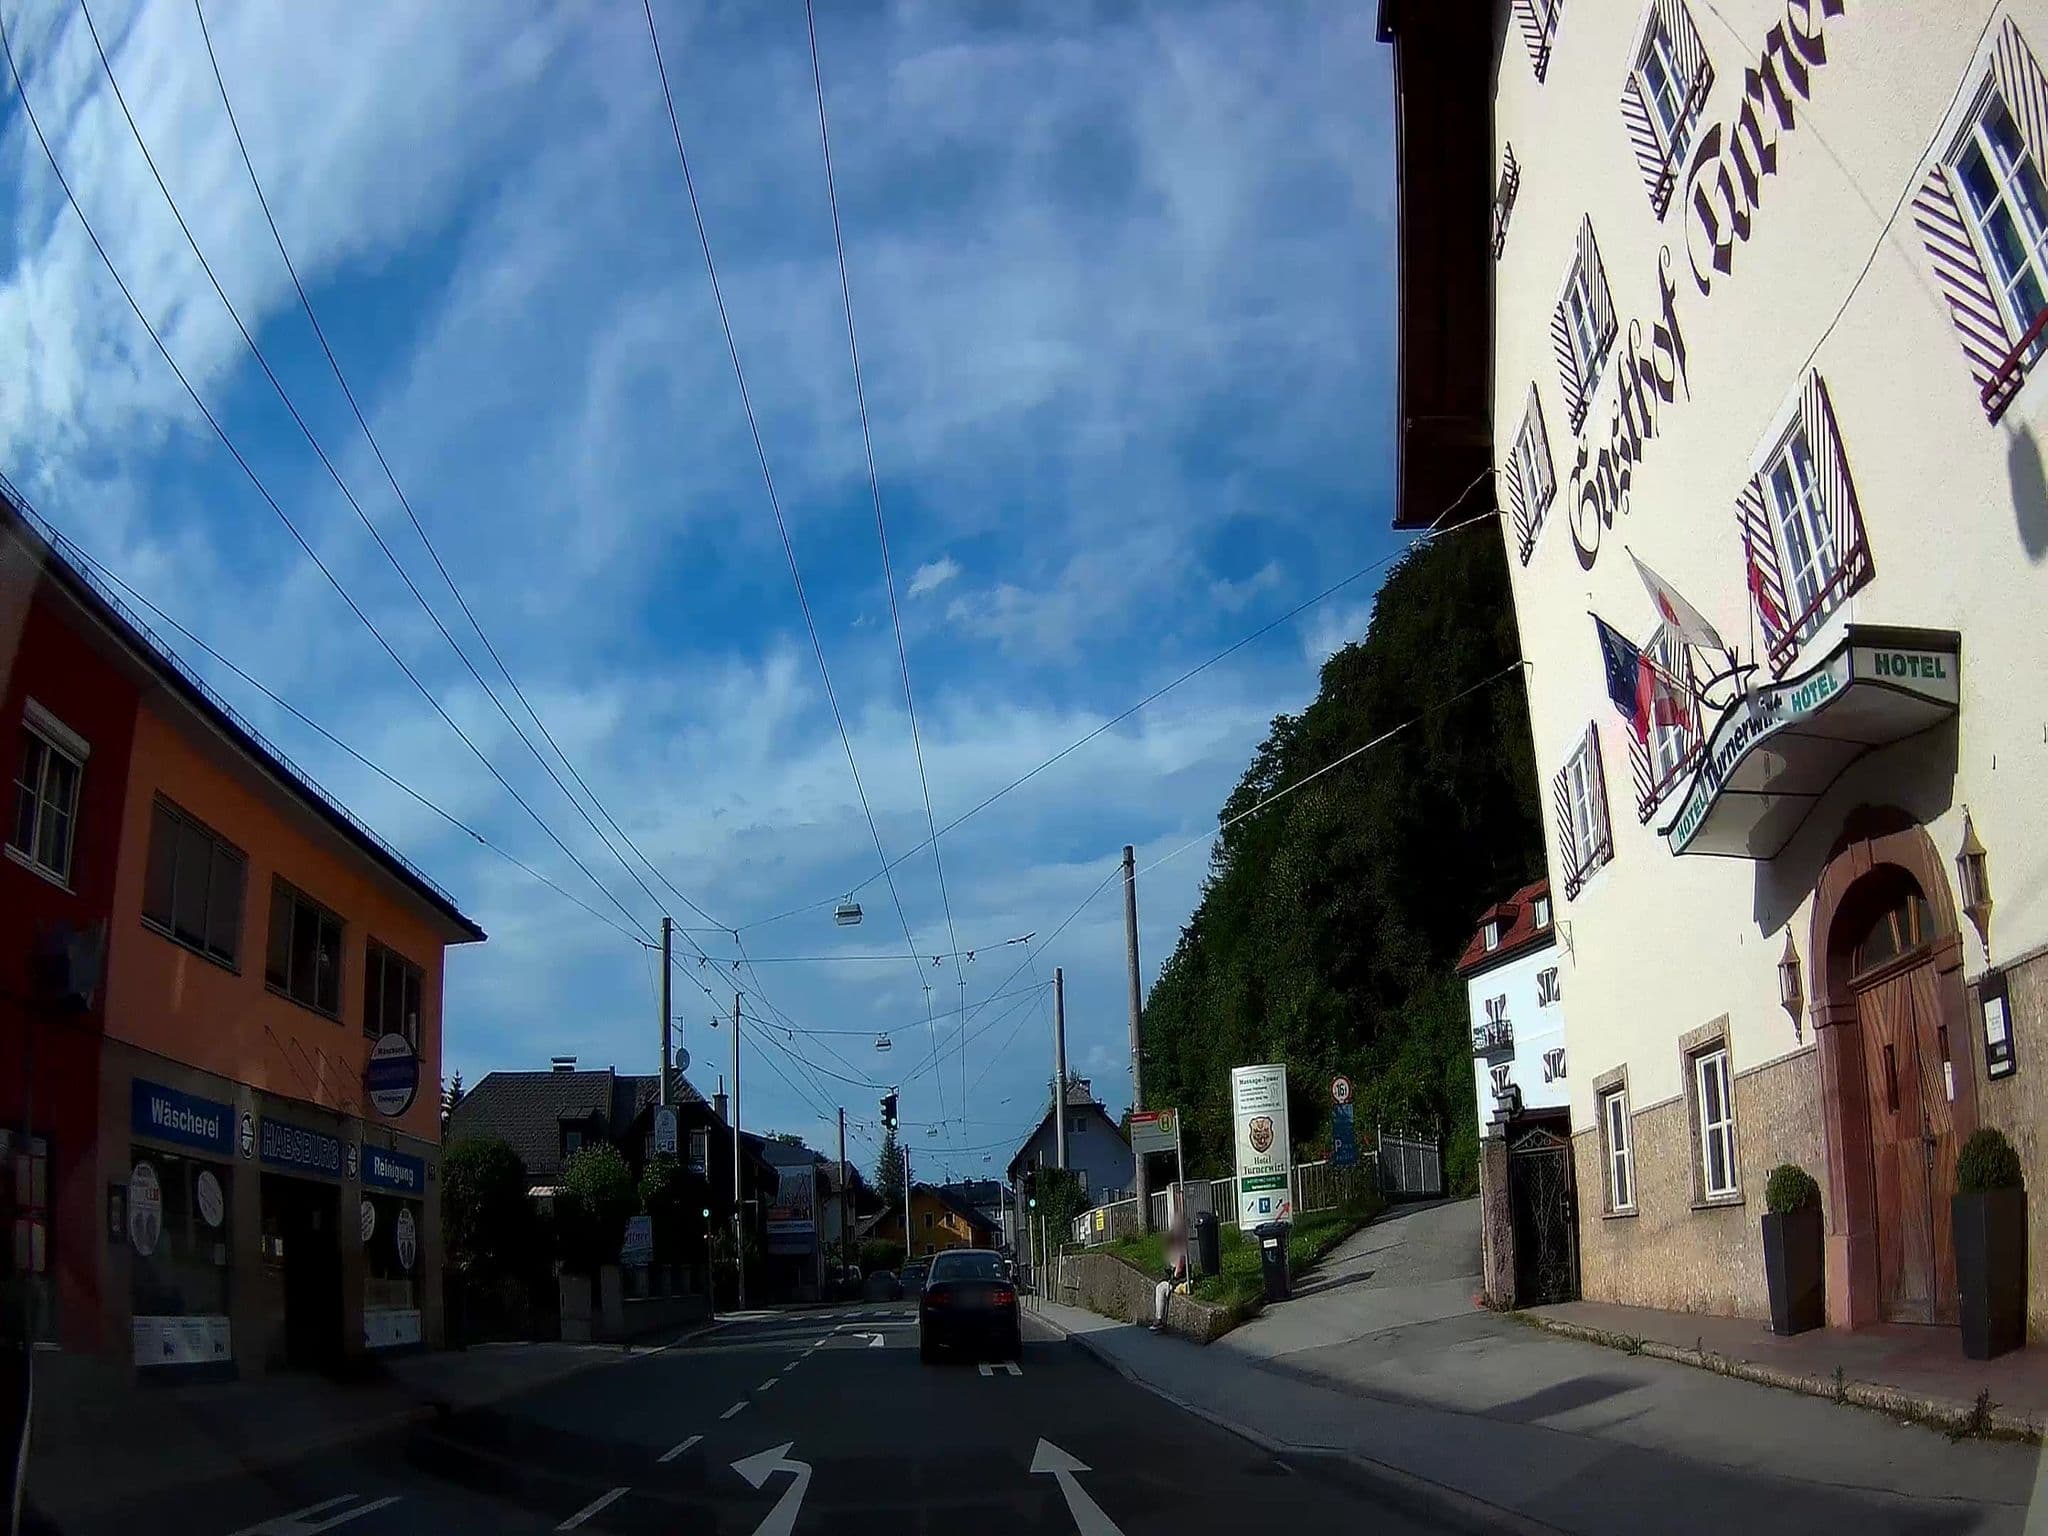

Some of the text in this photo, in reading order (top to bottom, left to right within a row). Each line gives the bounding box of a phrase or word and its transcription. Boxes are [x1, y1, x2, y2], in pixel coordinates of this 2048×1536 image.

[1568, 244, 1691, 571] Gasthof
[1874, 652, 1947, 679] HOTEL
[1677, 793, 1708, 842] HOTEL
[1790, 672, 1839, 713] HOTEL
[151, 1096, 219, 1140] Wäscherei
[262, 1121, 340, 1170] HABSBURG
[1254, 1155, 1272, 1165] Hotel
[374, 1156, 414, 1188] Reinigung
[1243, 1162, 1284, 1175] Turnerwirt
